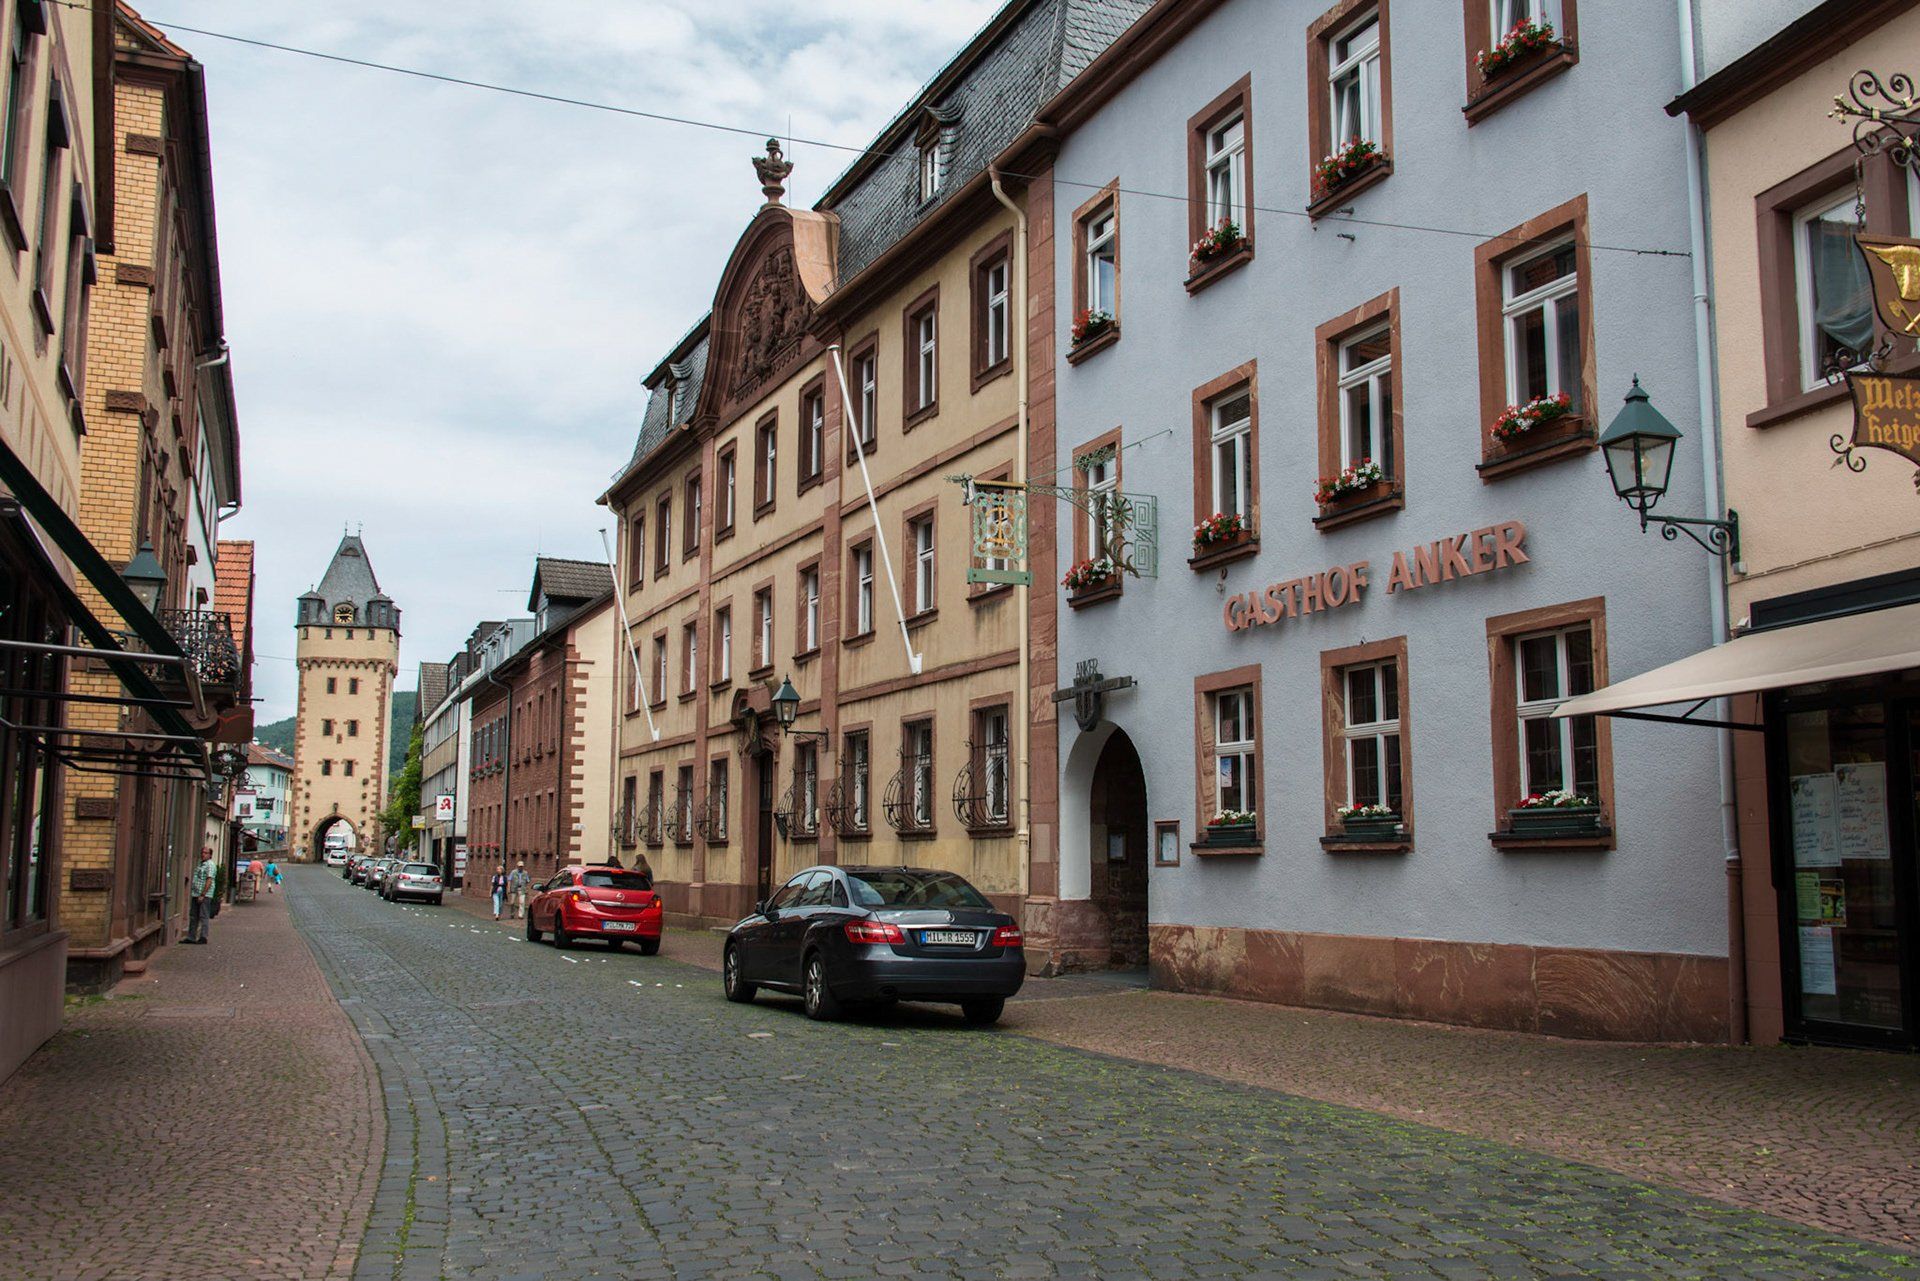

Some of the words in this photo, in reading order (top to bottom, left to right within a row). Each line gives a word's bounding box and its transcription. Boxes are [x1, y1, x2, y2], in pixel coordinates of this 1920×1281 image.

[1223, 560, 1370, 632] GASTHOF
[1386, 519, 1531, 594] ANKER
[926, 931, 942, 943] MIL
[955, 932, 974, 943] 1555
